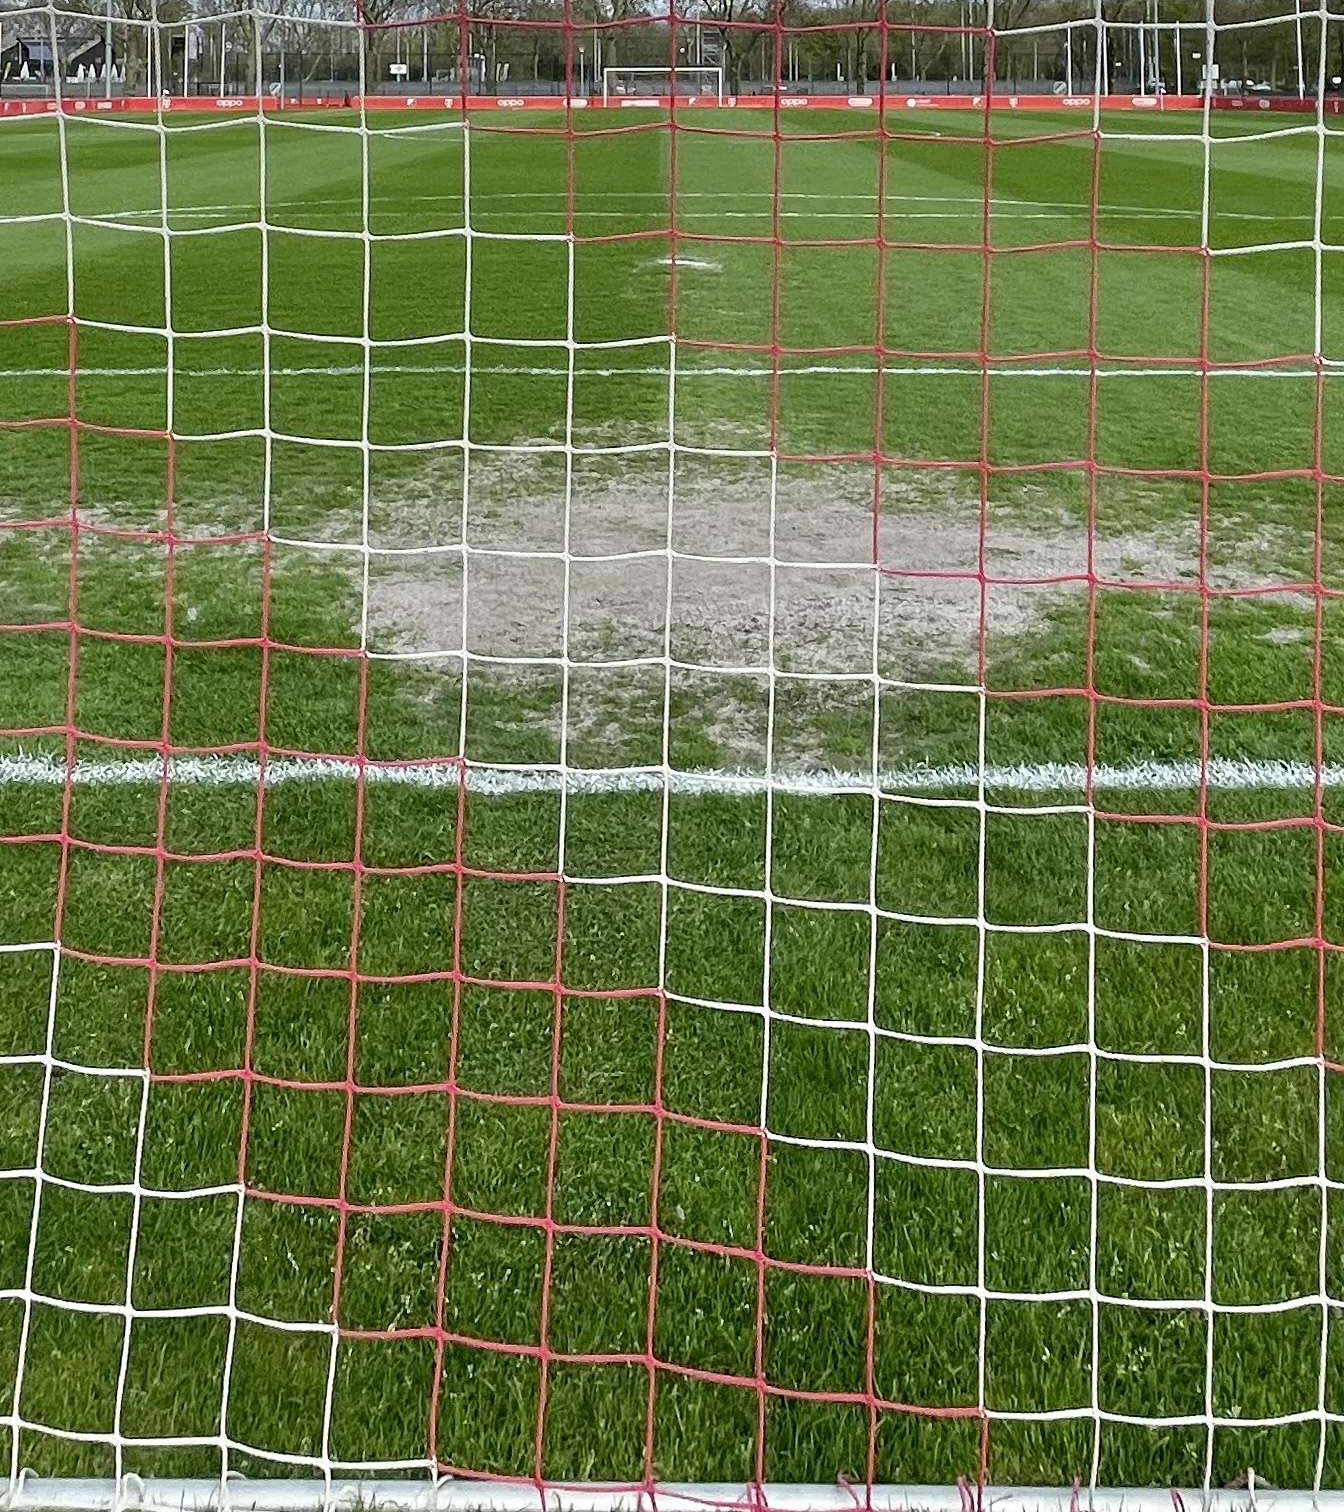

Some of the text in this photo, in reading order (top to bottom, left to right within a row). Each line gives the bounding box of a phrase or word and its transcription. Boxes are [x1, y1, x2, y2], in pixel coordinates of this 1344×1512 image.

[216, 99, 243, 108] oppo
[497, 99, 524, 107] oppo
[781, 98, 808, 107] oppo
[1062, 98, 1091, 107] oppo
